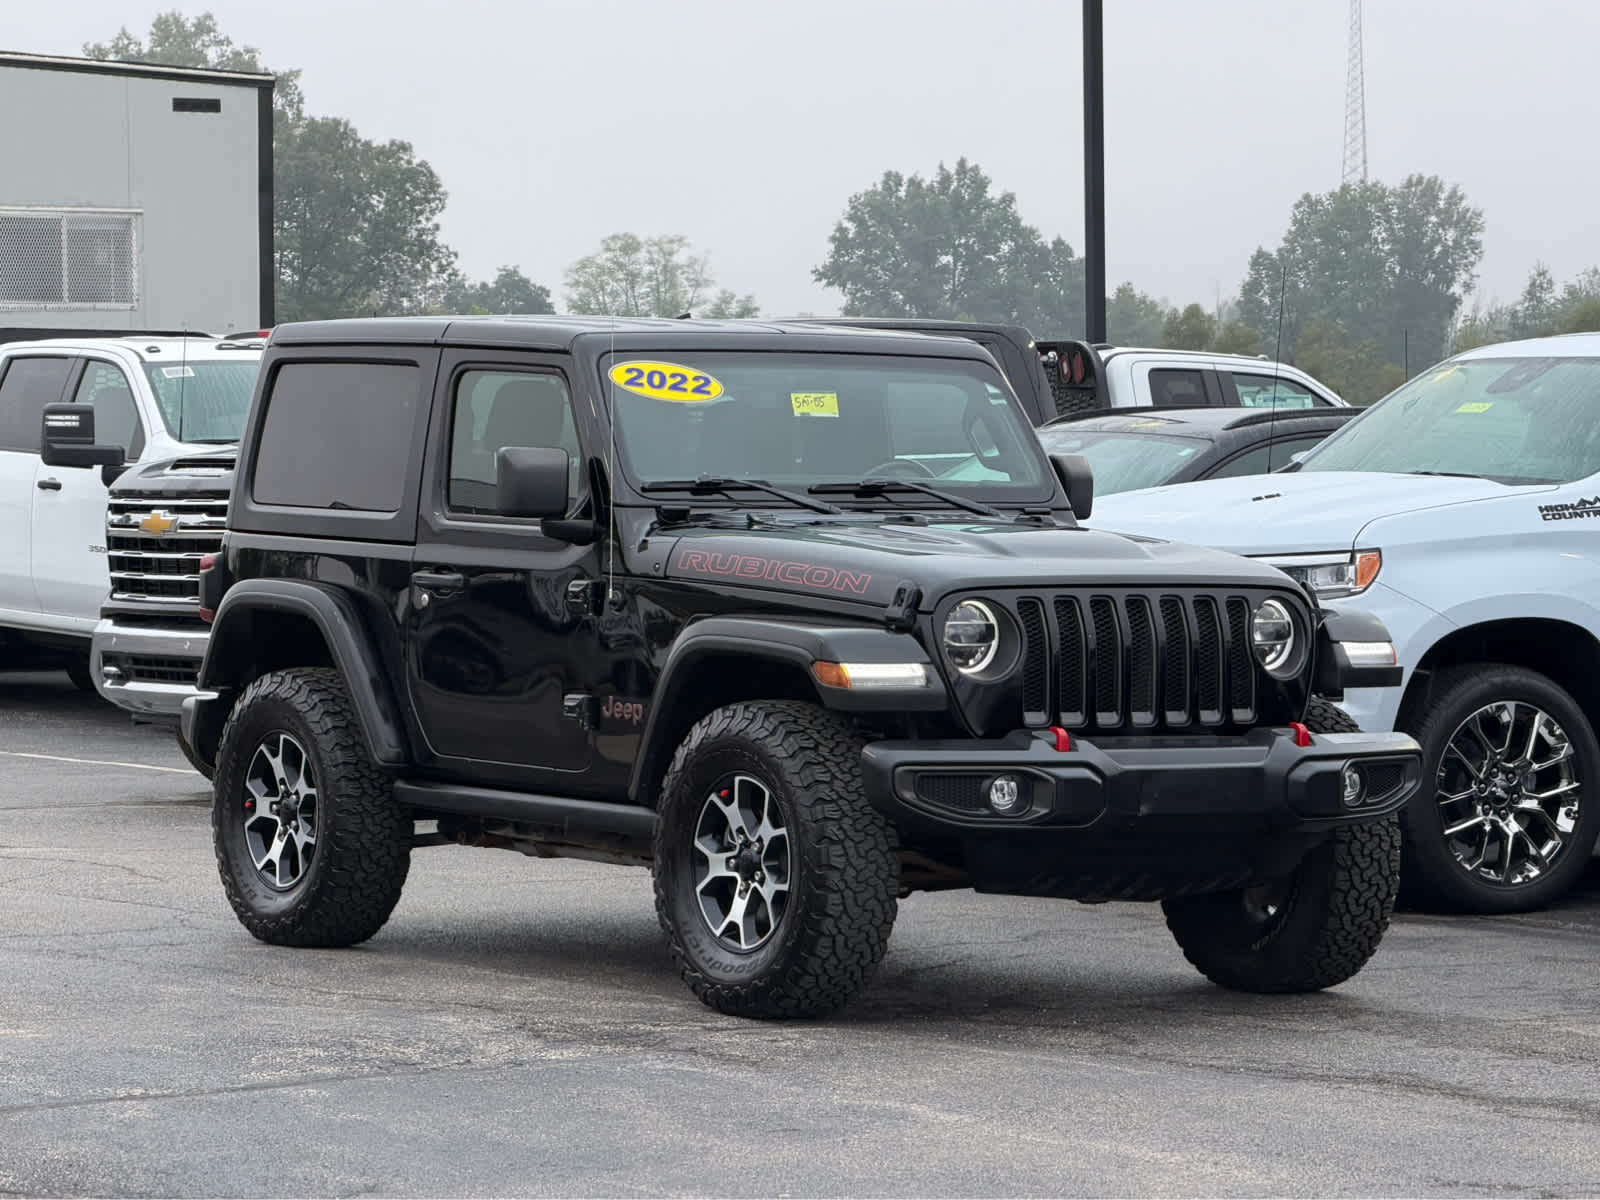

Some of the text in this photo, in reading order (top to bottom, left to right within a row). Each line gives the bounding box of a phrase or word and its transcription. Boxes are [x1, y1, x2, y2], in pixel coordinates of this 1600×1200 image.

[623, 367, 712, 396] 2022
[1538, 503, 1576, 513] HIGH
[678, 549, 872, 594] RUBICON
[602, 695, 643, 726] Jeep
